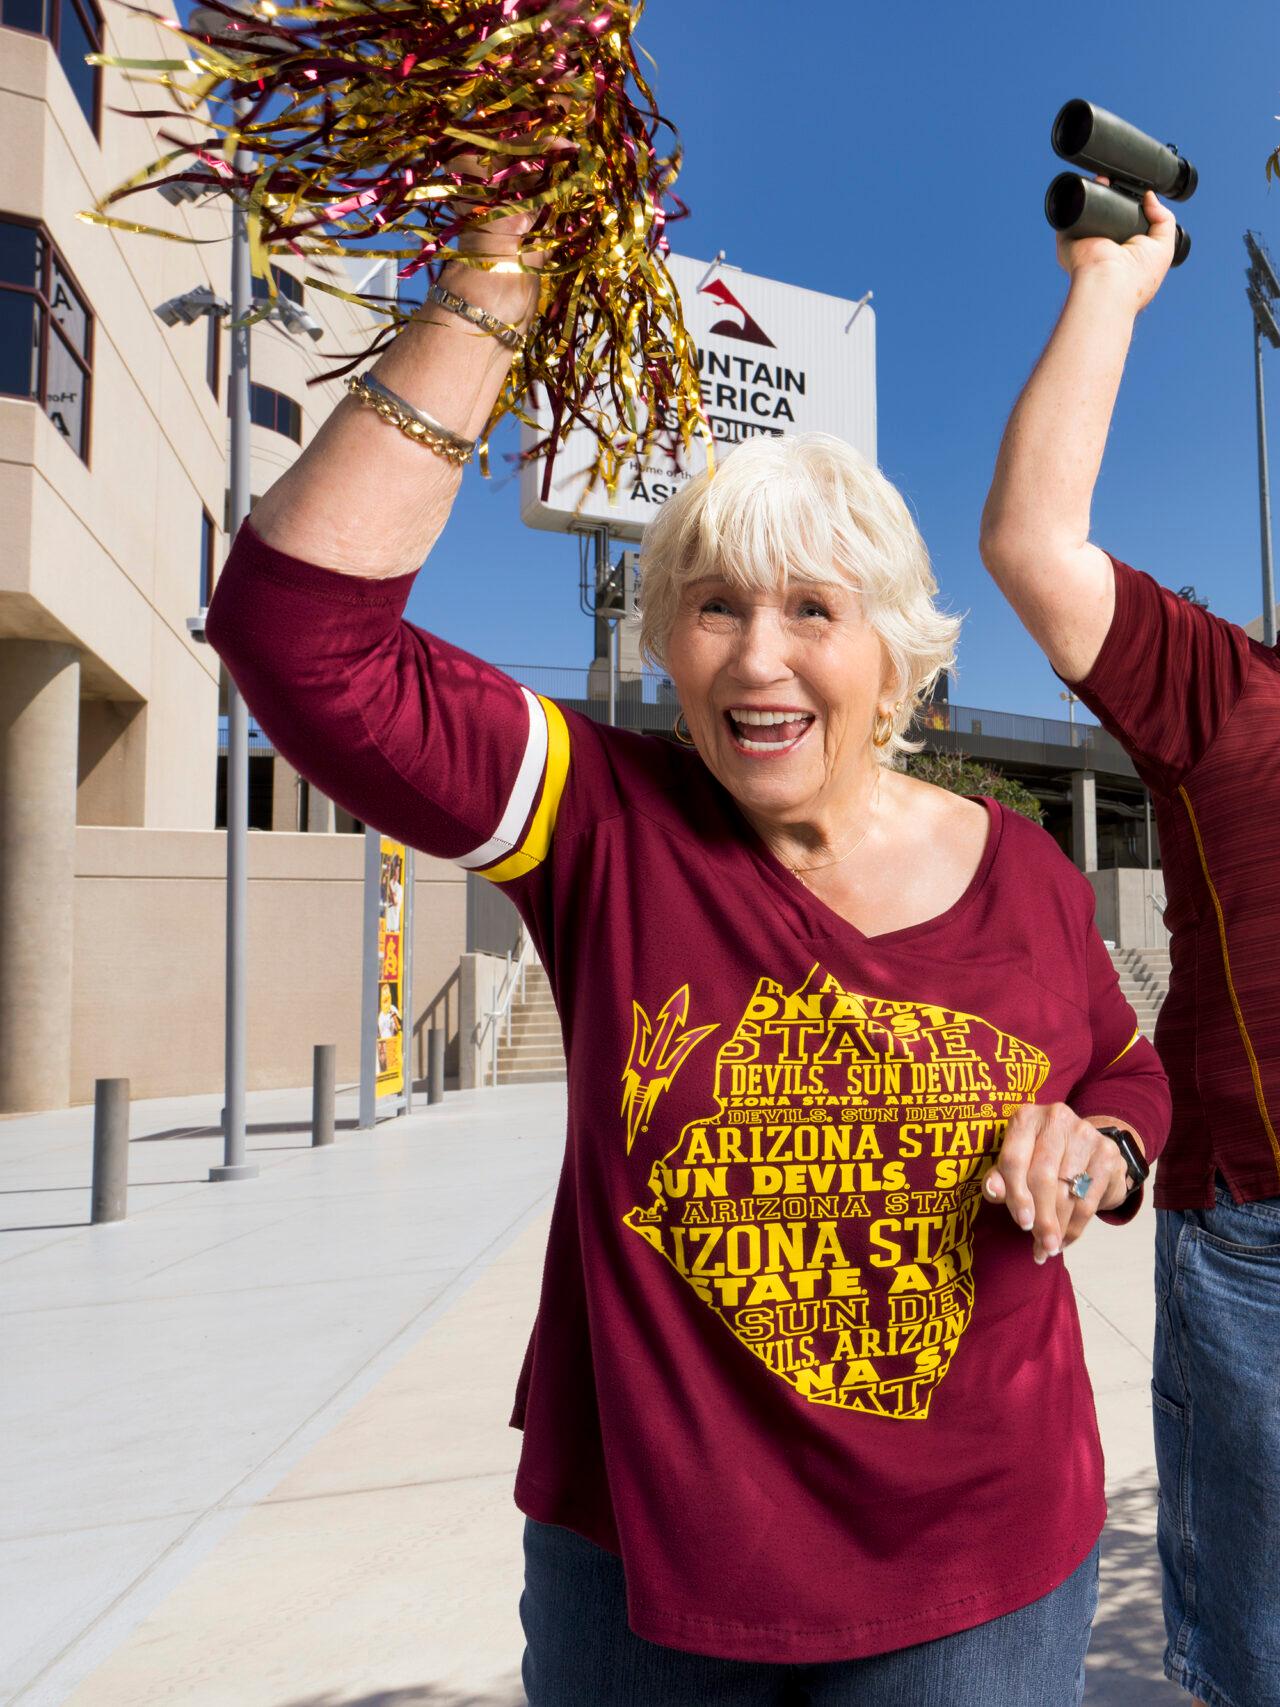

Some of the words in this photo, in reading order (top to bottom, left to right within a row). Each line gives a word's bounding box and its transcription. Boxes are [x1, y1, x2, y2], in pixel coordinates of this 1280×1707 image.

[699, 380, 796, 423] ERICA
[847, 1063, 901, 1096] SUN
[841, 1107, 899, 1124] SUN
[884, 1093, 981, 1106] ARIZONA
[683, 1124, 884, 1165] ARIZONA
[681, 1193, 872, 1224] ARIZONA
[734, 1297, 871, 1342] SUN
